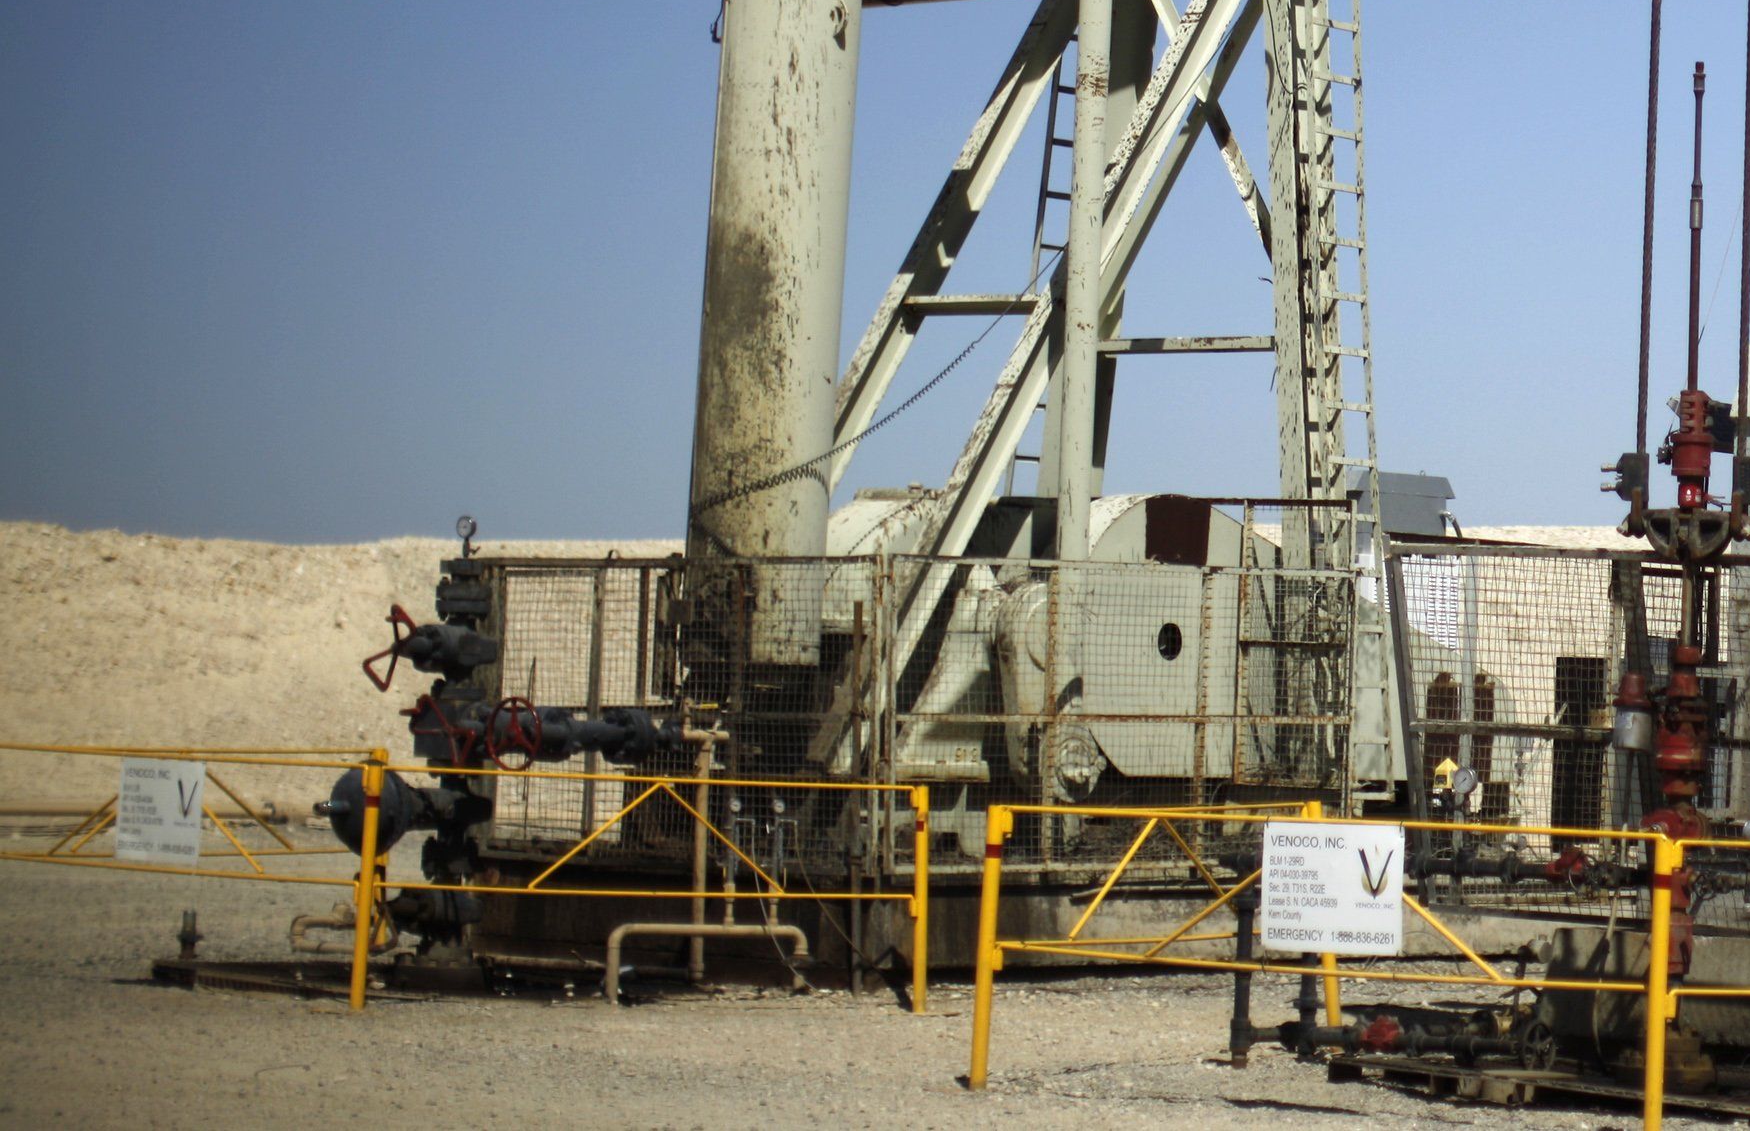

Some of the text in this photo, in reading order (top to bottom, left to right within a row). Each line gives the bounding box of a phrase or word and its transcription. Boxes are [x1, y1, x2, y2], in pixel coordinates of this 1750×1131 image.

[1270, 835, 1347, 850] VENOCO, INC.
[1269, 855, 1283, 866] BLM
[1269, 869, 1279, 879] API
[1268, 896, 1285, 906] Lease
[1301, 897, 1319, 908] CACA
[1282, 909, 1302, 923] County
[1267, 928, 1324, 942] EMERGENCY
